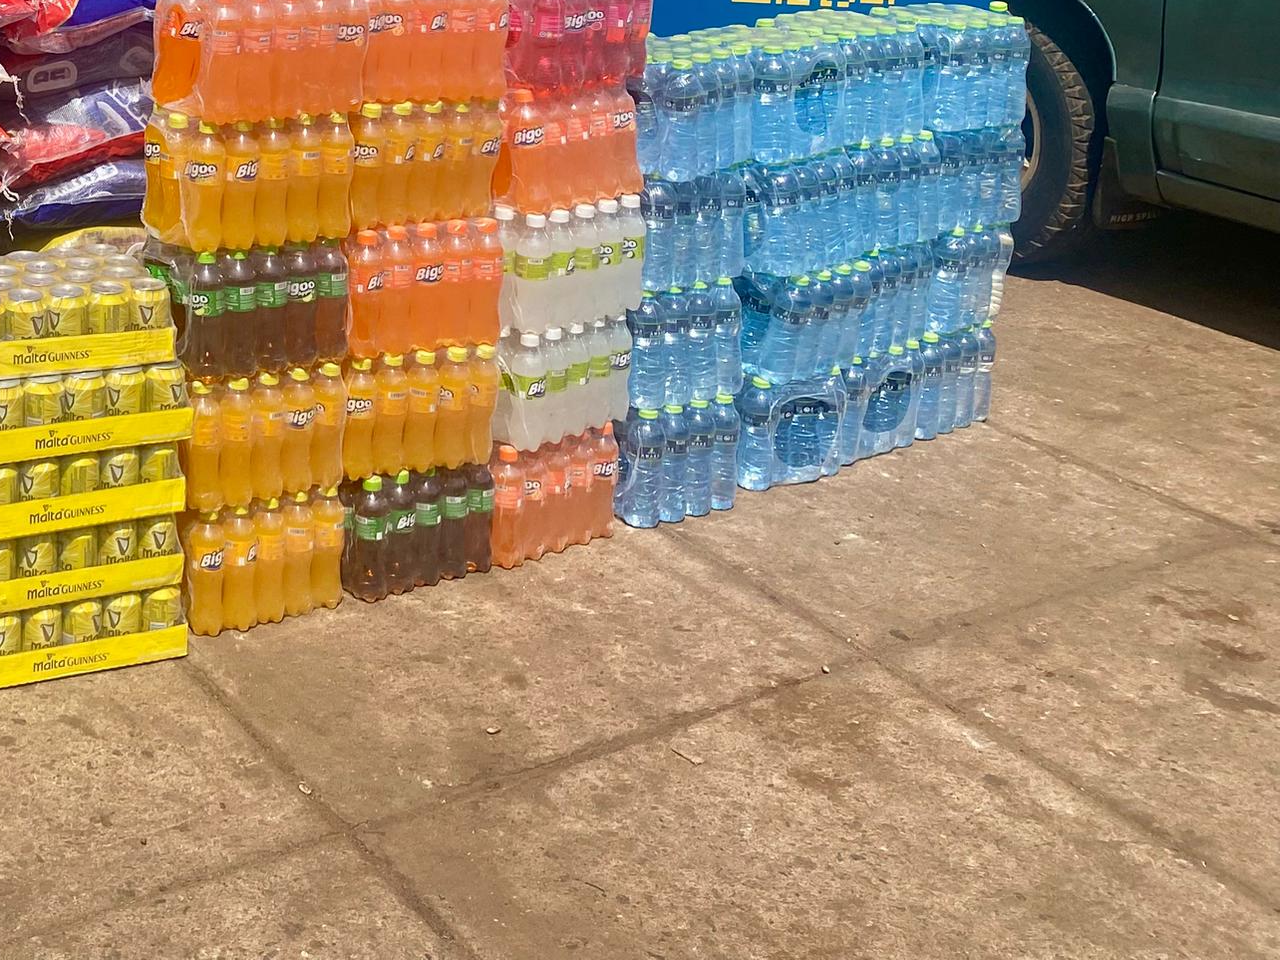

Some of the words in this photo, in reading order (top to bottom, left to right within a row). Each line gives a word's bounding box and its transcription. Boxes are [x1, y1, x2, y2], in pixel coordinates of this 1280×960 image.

[13, 353, 46, 365] Malta
[48, 351, 90, 362] GUINNESS
[35, 437, 68, 450] Malta
[70, 434, 111, 447] GUINNESS
[30, 510, 62, 525] Malta
[63, 506, 104, 520] GUINNESS
[27, 586, 60, 601] Malta
[61, 581, 102, 594] GUINNESS
[33, 659, 65, 672] Malta
[67, 654, 108, 667] GUINNESS
